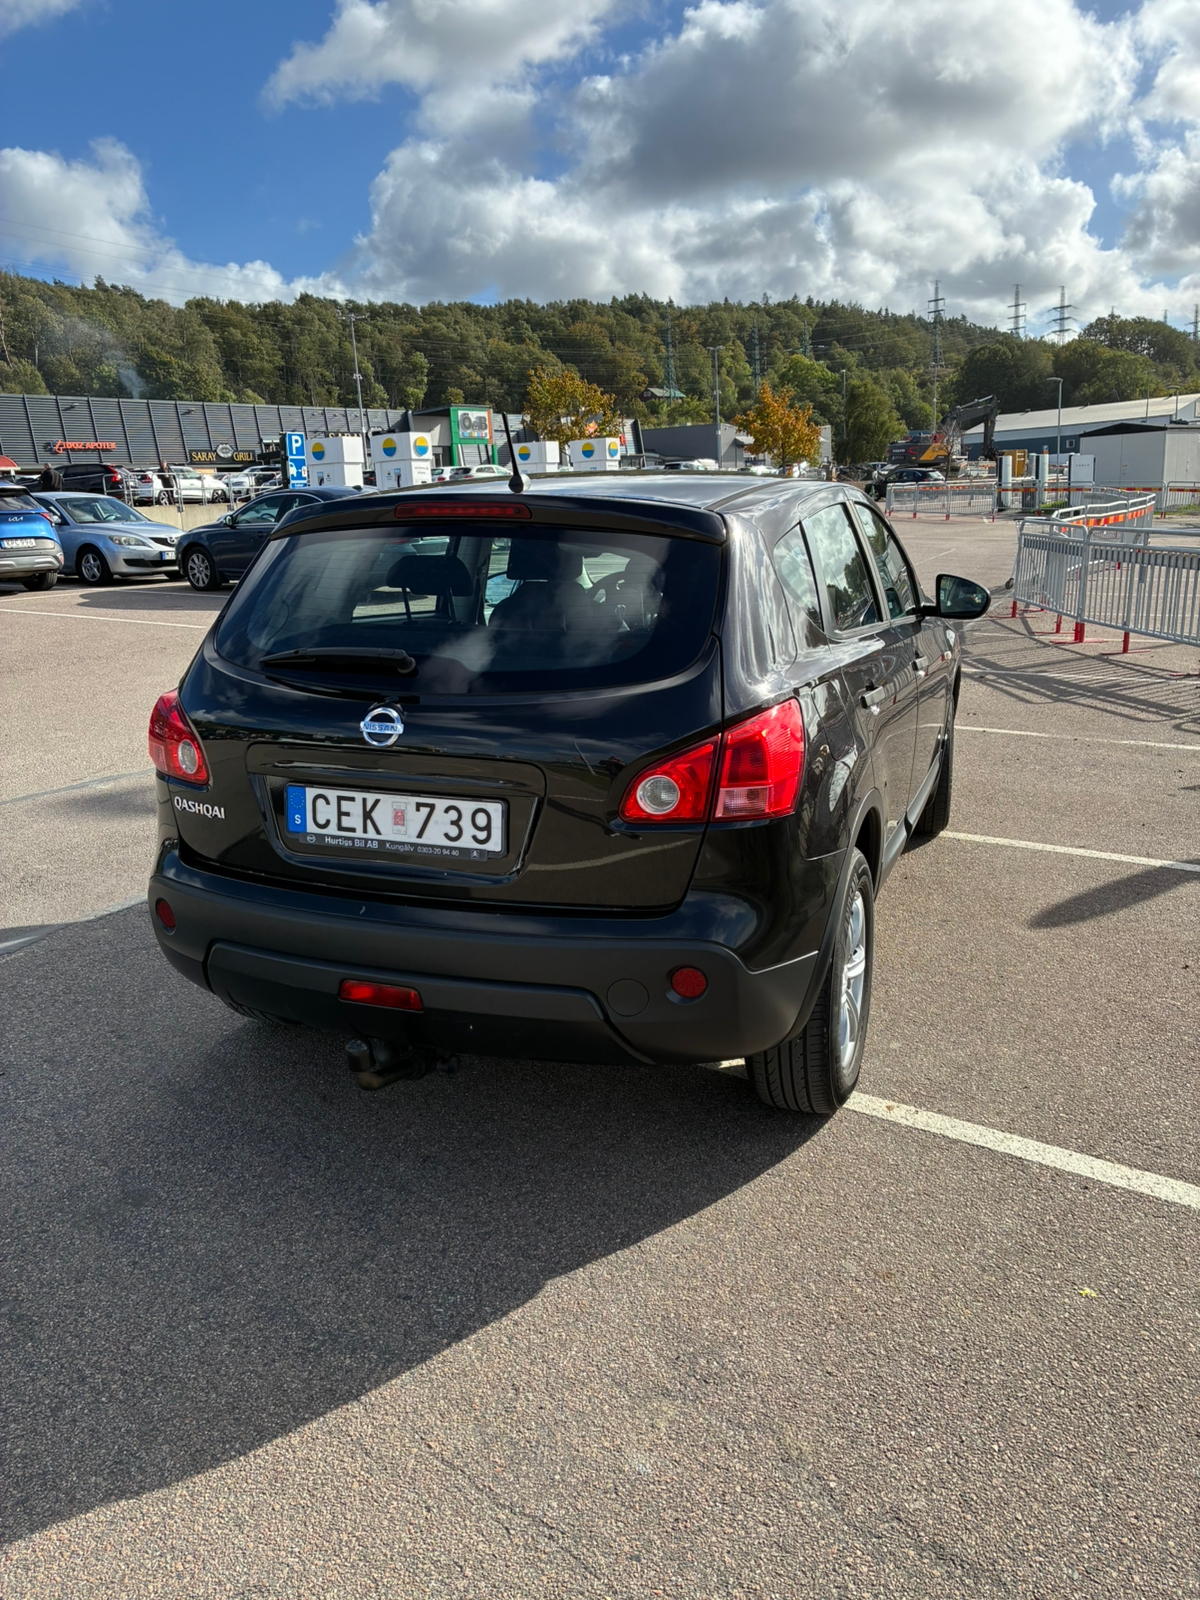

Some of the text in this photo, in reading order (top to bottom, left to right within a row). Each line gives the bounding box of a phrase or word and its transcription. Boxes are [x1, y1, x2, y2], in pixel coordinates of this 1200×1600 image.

[66, 441, 83, 449] DOZ
[291, 435, 302, 455] P
[191, 451, 254, 461] SARAY GRILL
[363, 723, 398, 732] NISSAN
[174, 796, 225, 819] QASHQAI
[294, 814, 302, 824] S
[311, 793, 492, 845] CEK 739
[325, 835, 353, 847] Hurtigs
[354, 838, 365, 847] Bil
[366, 840, 379, 849] AB
